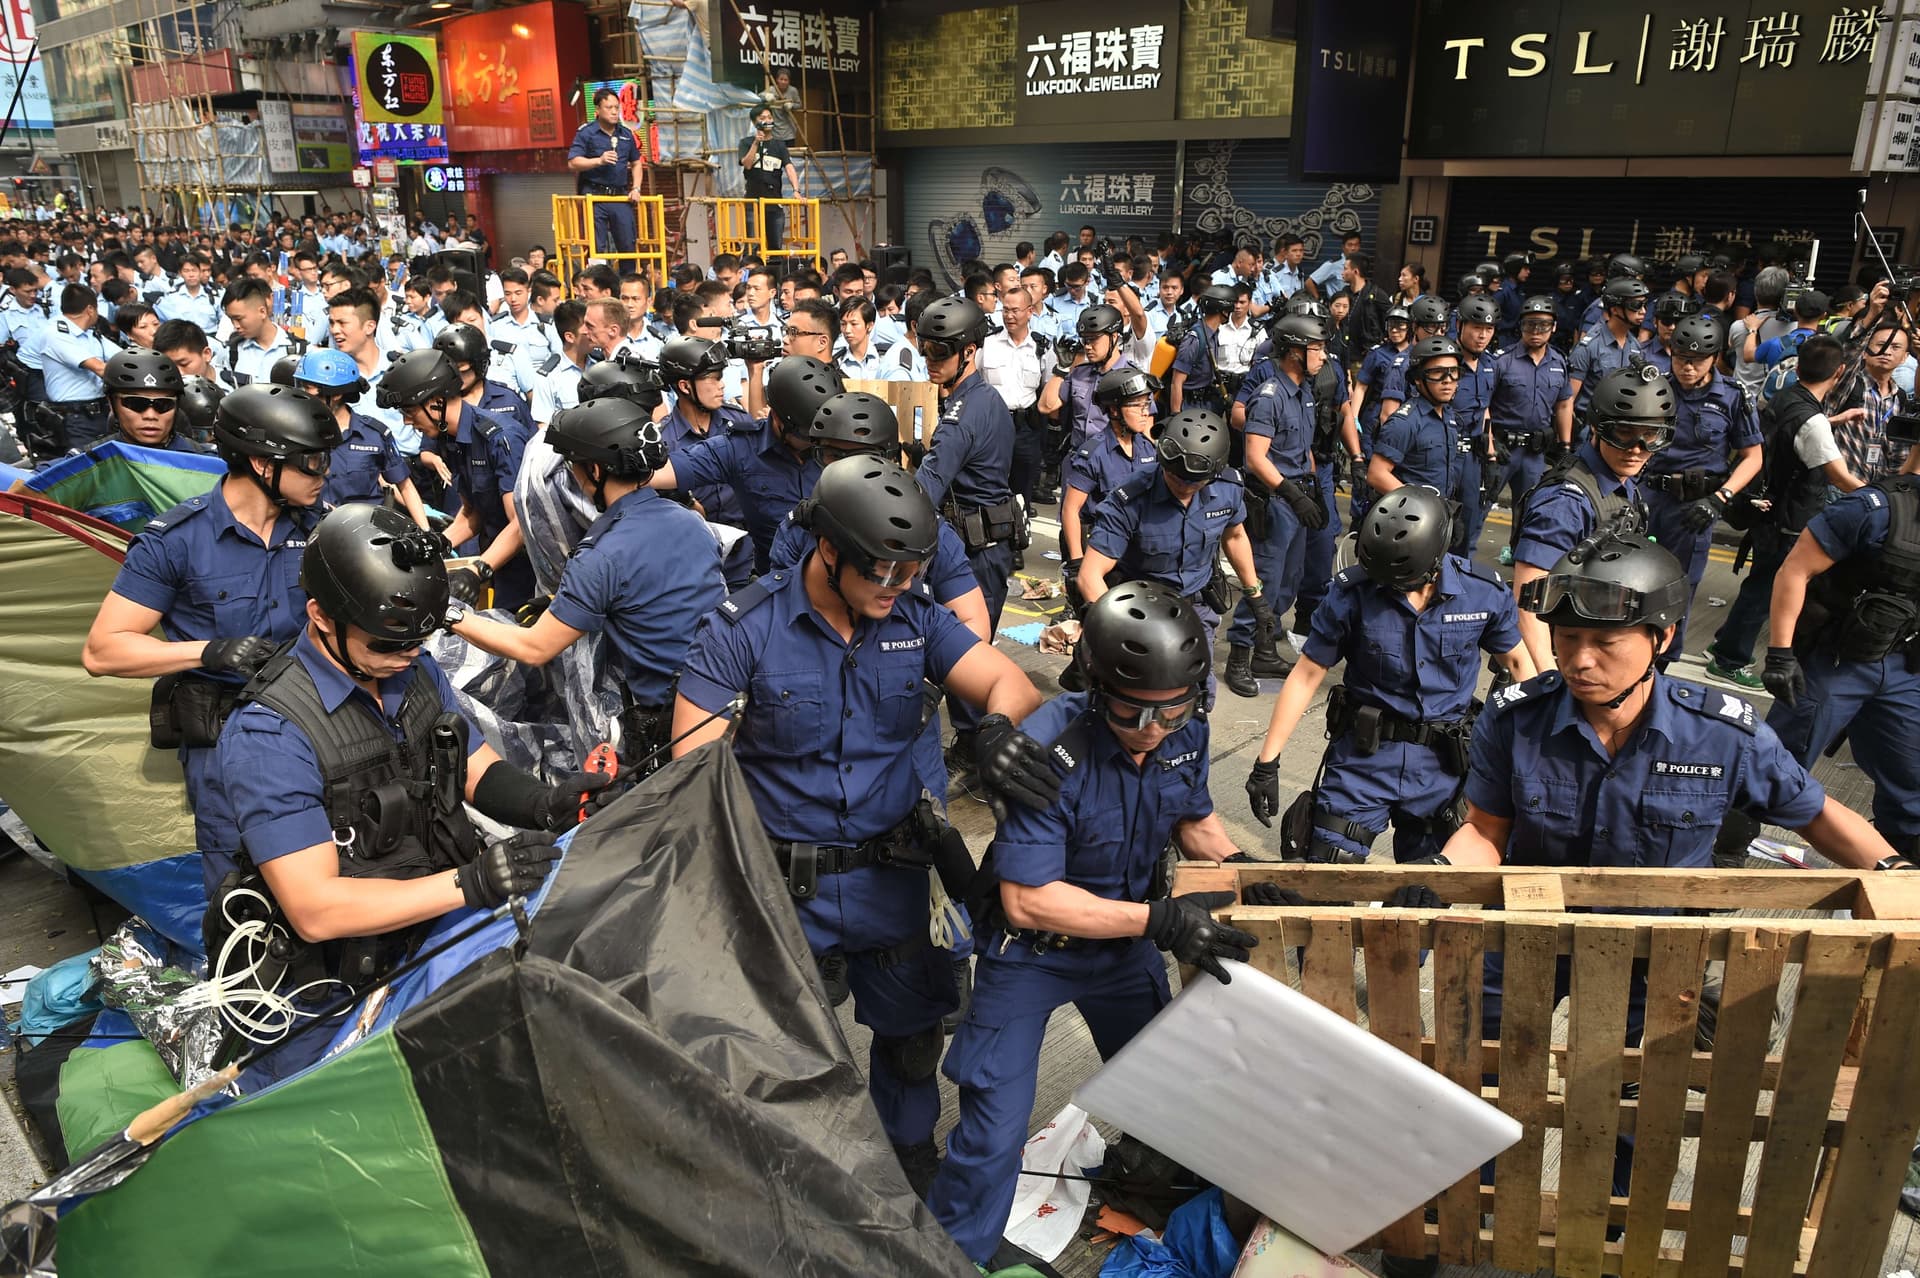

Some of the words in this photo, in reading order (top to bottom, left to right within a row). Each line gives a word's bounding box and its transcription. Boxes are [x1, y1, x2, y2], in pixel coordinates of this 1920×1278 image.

[739, 5, 860, 56] 六福珠寶
[1669, 6, 1888, 72] 謝瑞麟
[1026, 24, 1164, 78] 六福珠寶
[1320, 48, 1355, 72] TSL
[1443, 31, 1614, 80] TSL
[1026, 77, 1083, 96] LUKFOOK
[1084, 72, 1162, 92] JEWELLERY
[1060, 173, 1156, 203] 六福珠寶
[1060, 204, 1098, 215] LUKFOOK
[1102, 205, 1153, 216] JEWELLERY
[1454, 613, 1481, 621] POLICE
[891, 638, 922, 649] POLICE
[1669, 765, 1709, 775] POLICE
